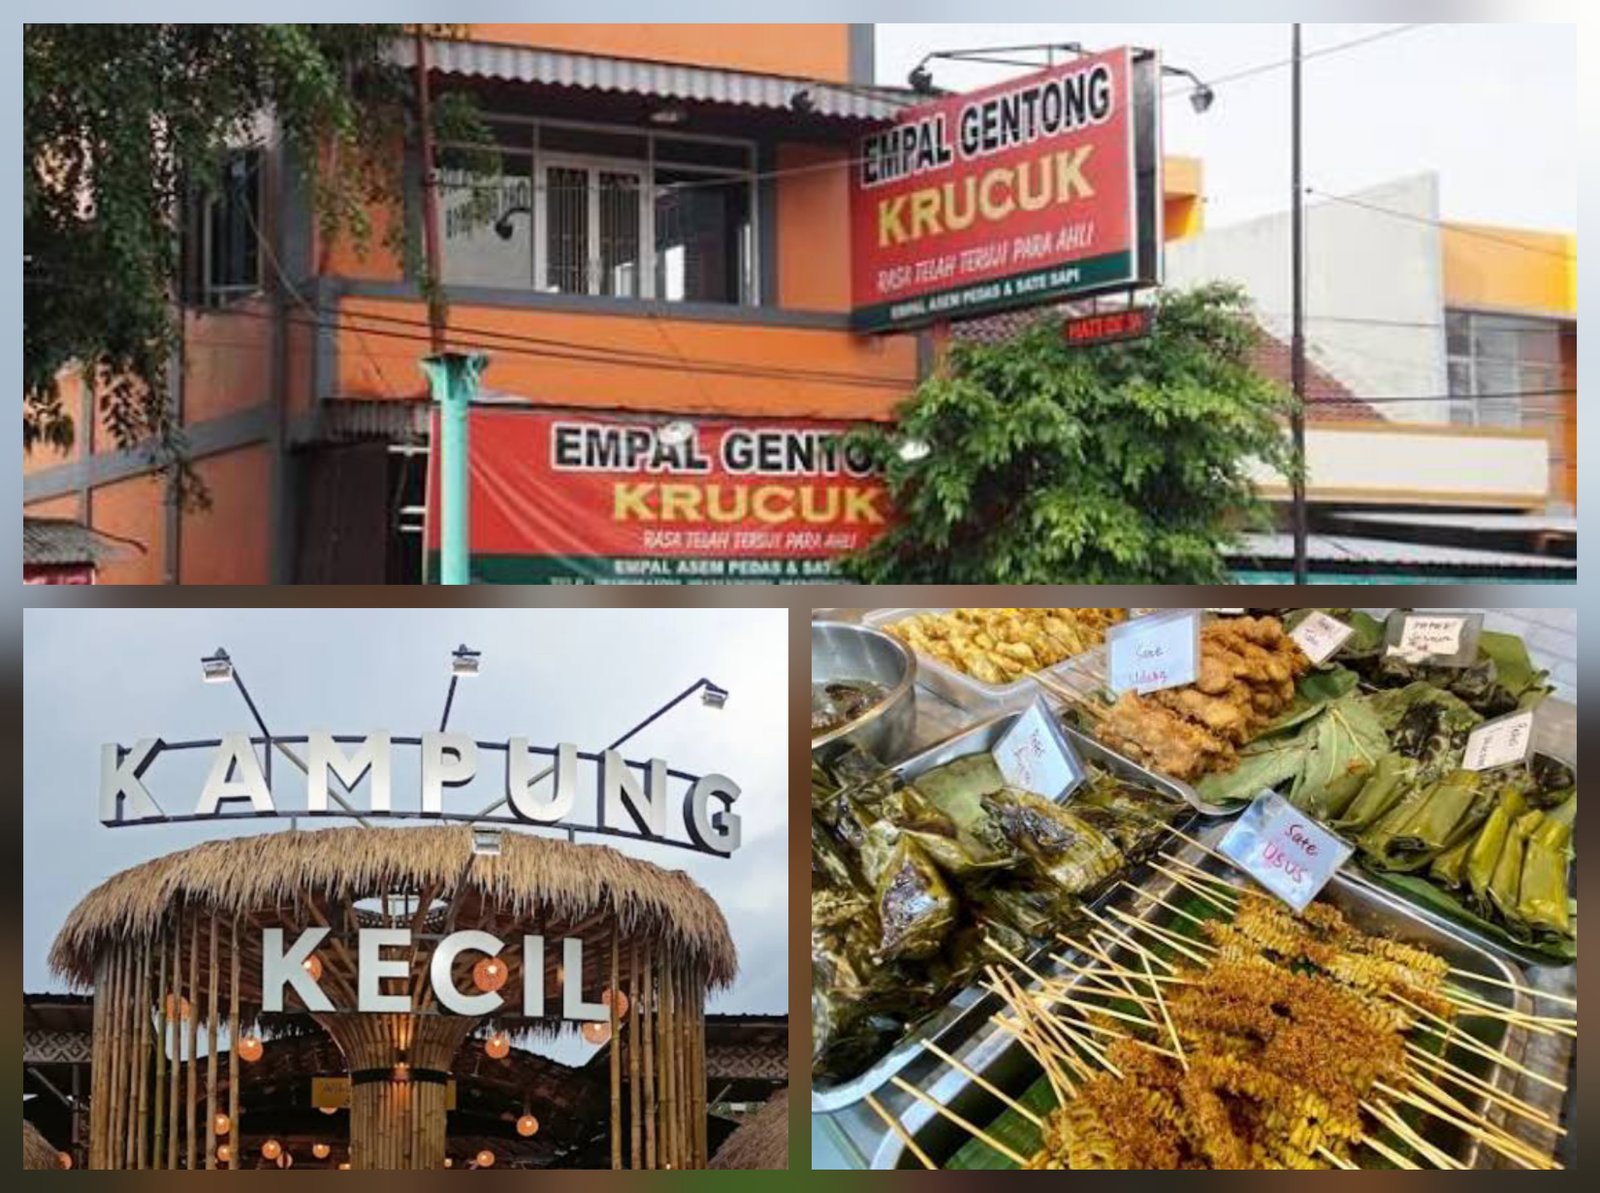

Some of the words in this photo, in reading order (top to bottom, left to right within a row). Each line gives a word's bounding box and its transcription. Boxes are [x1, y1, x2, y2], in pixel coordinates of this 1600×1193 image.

[861, 114, 953, 187] EMPAL
[960, 65, 1112, 160] GENTONG
[877, 145, 1095, 247] KRUCUK
[915, 254, 957, 284] TELAH
[1012, 233, 1052, 262] PARA
[1016, 275, 1047, 293] SATE
[1050, 268, 1081, 286] SAPI
[553, 424, 711, 472] EMPAL
[722, 431, 887, 474] GENTO
[613, 482, 886, 524] KRUCUK
[643, 531, 682, 549] RASA
[686, 532, 730, 549] TELAH
[786, 533, 822, 549] PARA
[614, 559, 671, 575] EMPAL
[676, 559, 724, 575] ASEM
[728, 559, 782, 575] PEDAS
[785, 559, 799, 575] &
[801, 559, 843, 575] SAT
[100, 730, 743, 856] KAMPUNG
[1284, 823, 1319, 857] Sate
[261, 926, 611, 1023] KECIL
